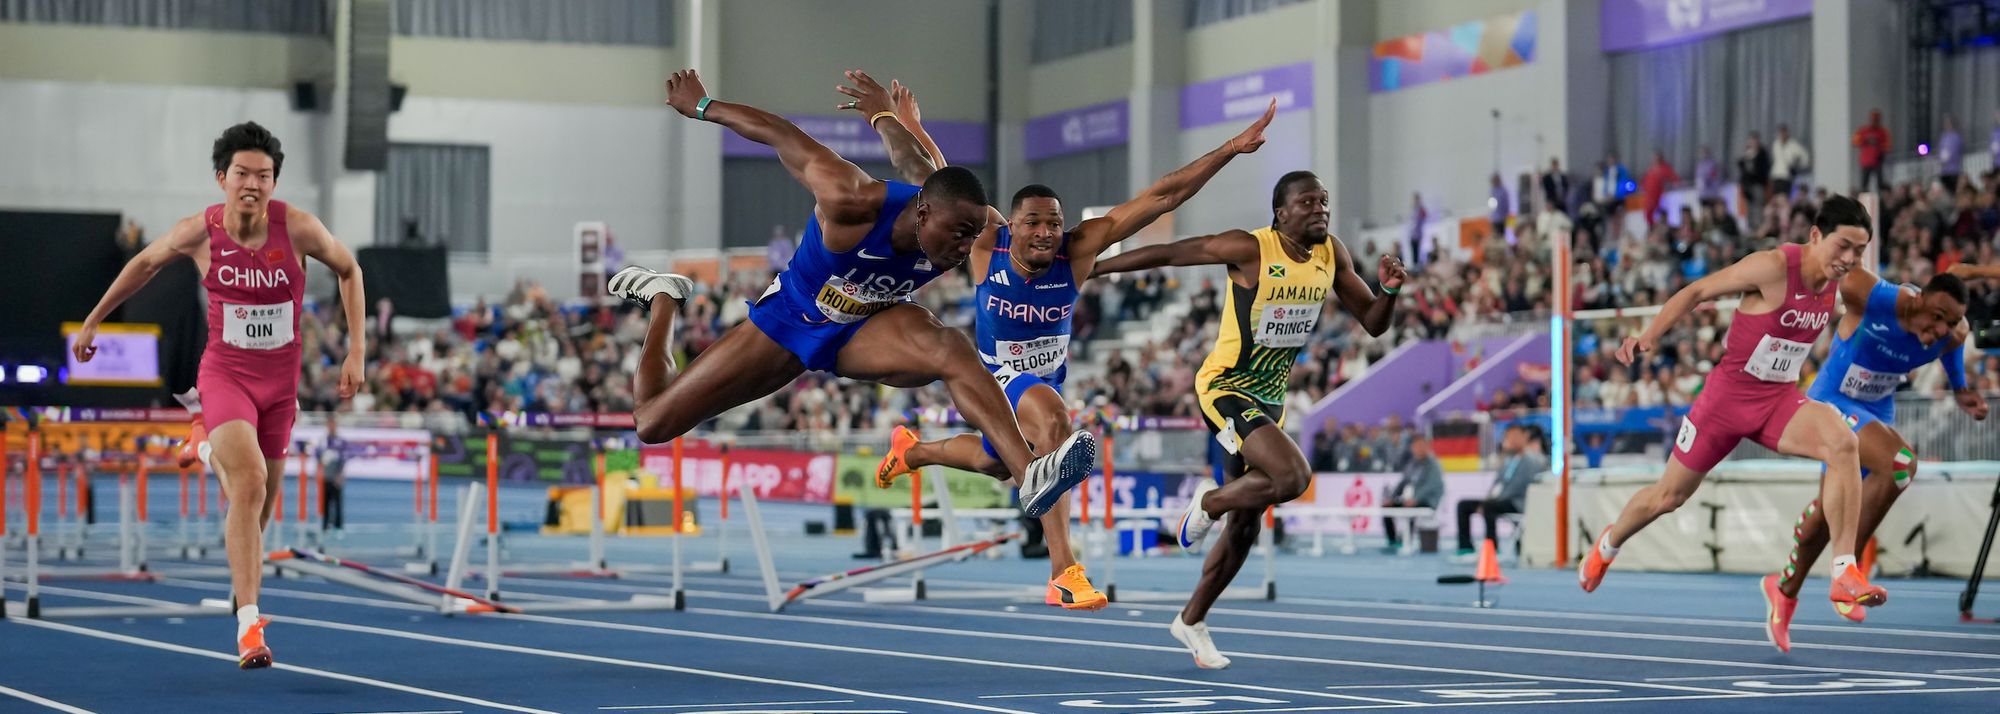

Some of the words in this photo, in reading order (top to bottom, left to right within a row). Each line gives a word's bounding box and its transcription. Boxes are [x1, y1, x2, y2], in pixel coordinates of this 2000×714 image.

[217, 265, 290, 288] CHINA
[1266, 286, 1327, 301] JAMAICA
[986, 294, 1072, 323] FRANCE
[1780, 309, 1830, 330] CHINA
[245, 323, 273, 339] QIN
[1265, 320, 1313, 336] PRINCE
[1771, 358, 1792, 372] LIU
